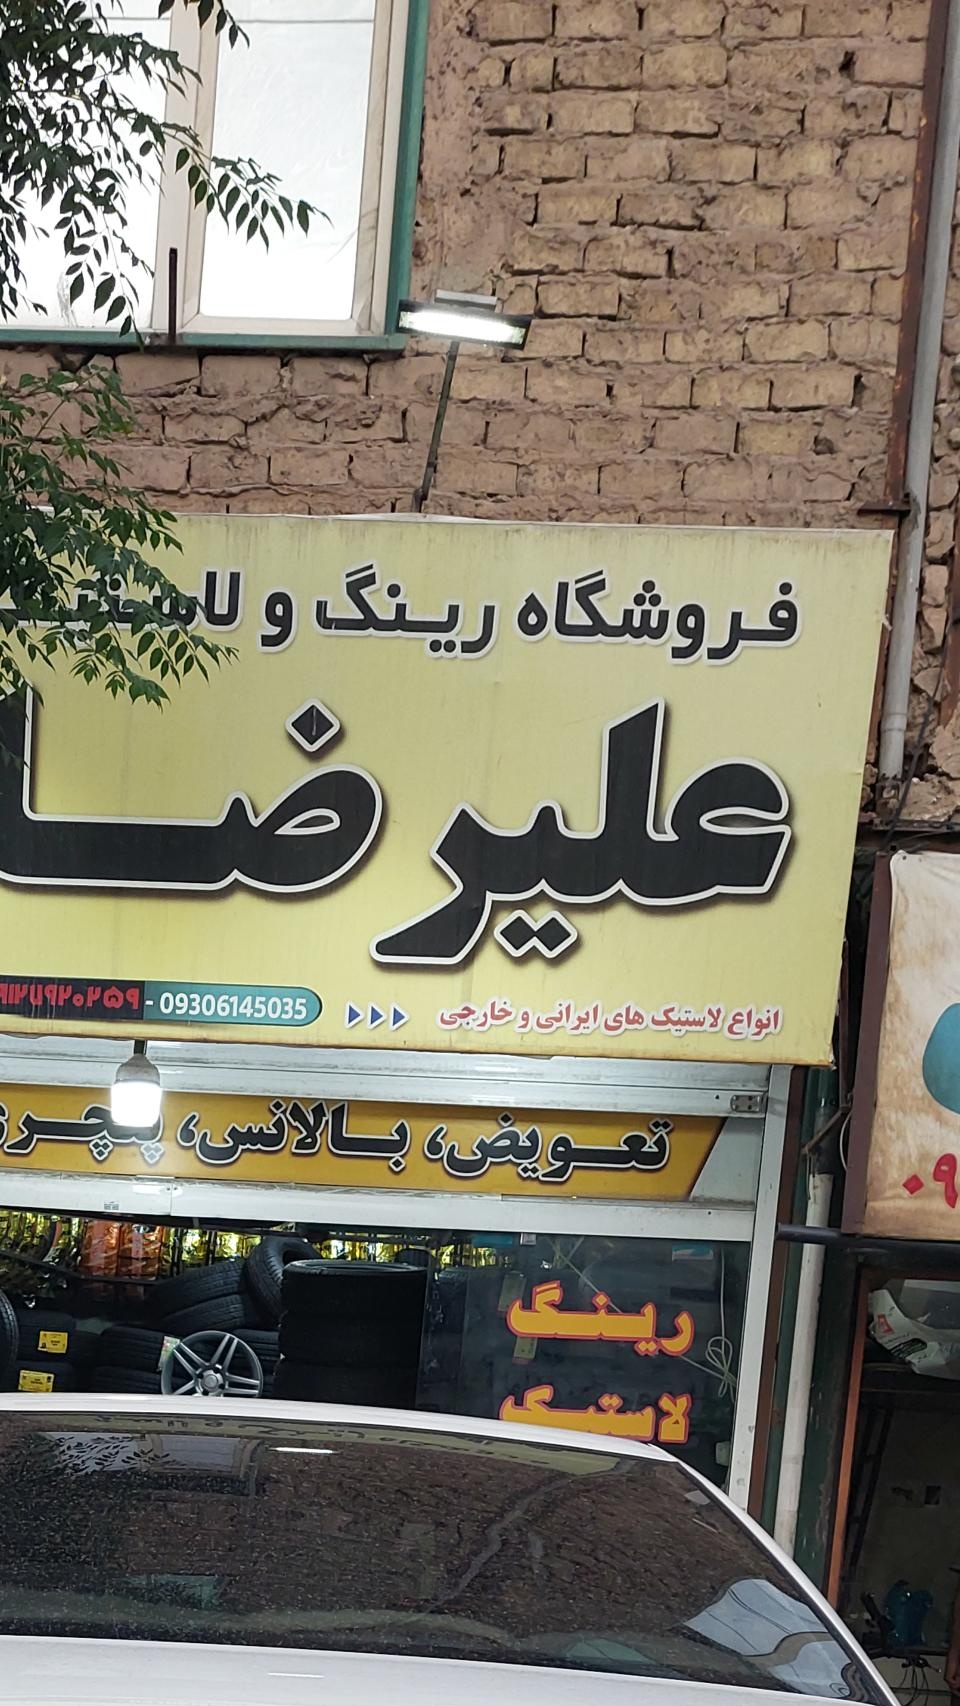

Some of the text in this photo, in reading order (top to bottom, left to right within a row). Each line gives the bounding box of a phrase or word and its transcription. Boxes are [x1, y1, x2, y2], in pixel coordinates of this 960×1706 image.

[260, 590, 296, 648] و
[316, 562, 496, 655] رینگ
[517, 569, 800, 661] فروشگاه
[159, 991, 308, 1020] 09306145035
[439, 1000, 780, 1037] انواع لاستیک های ایرانی و خارجی
[506, 1280, 695, 1357] رینگ
